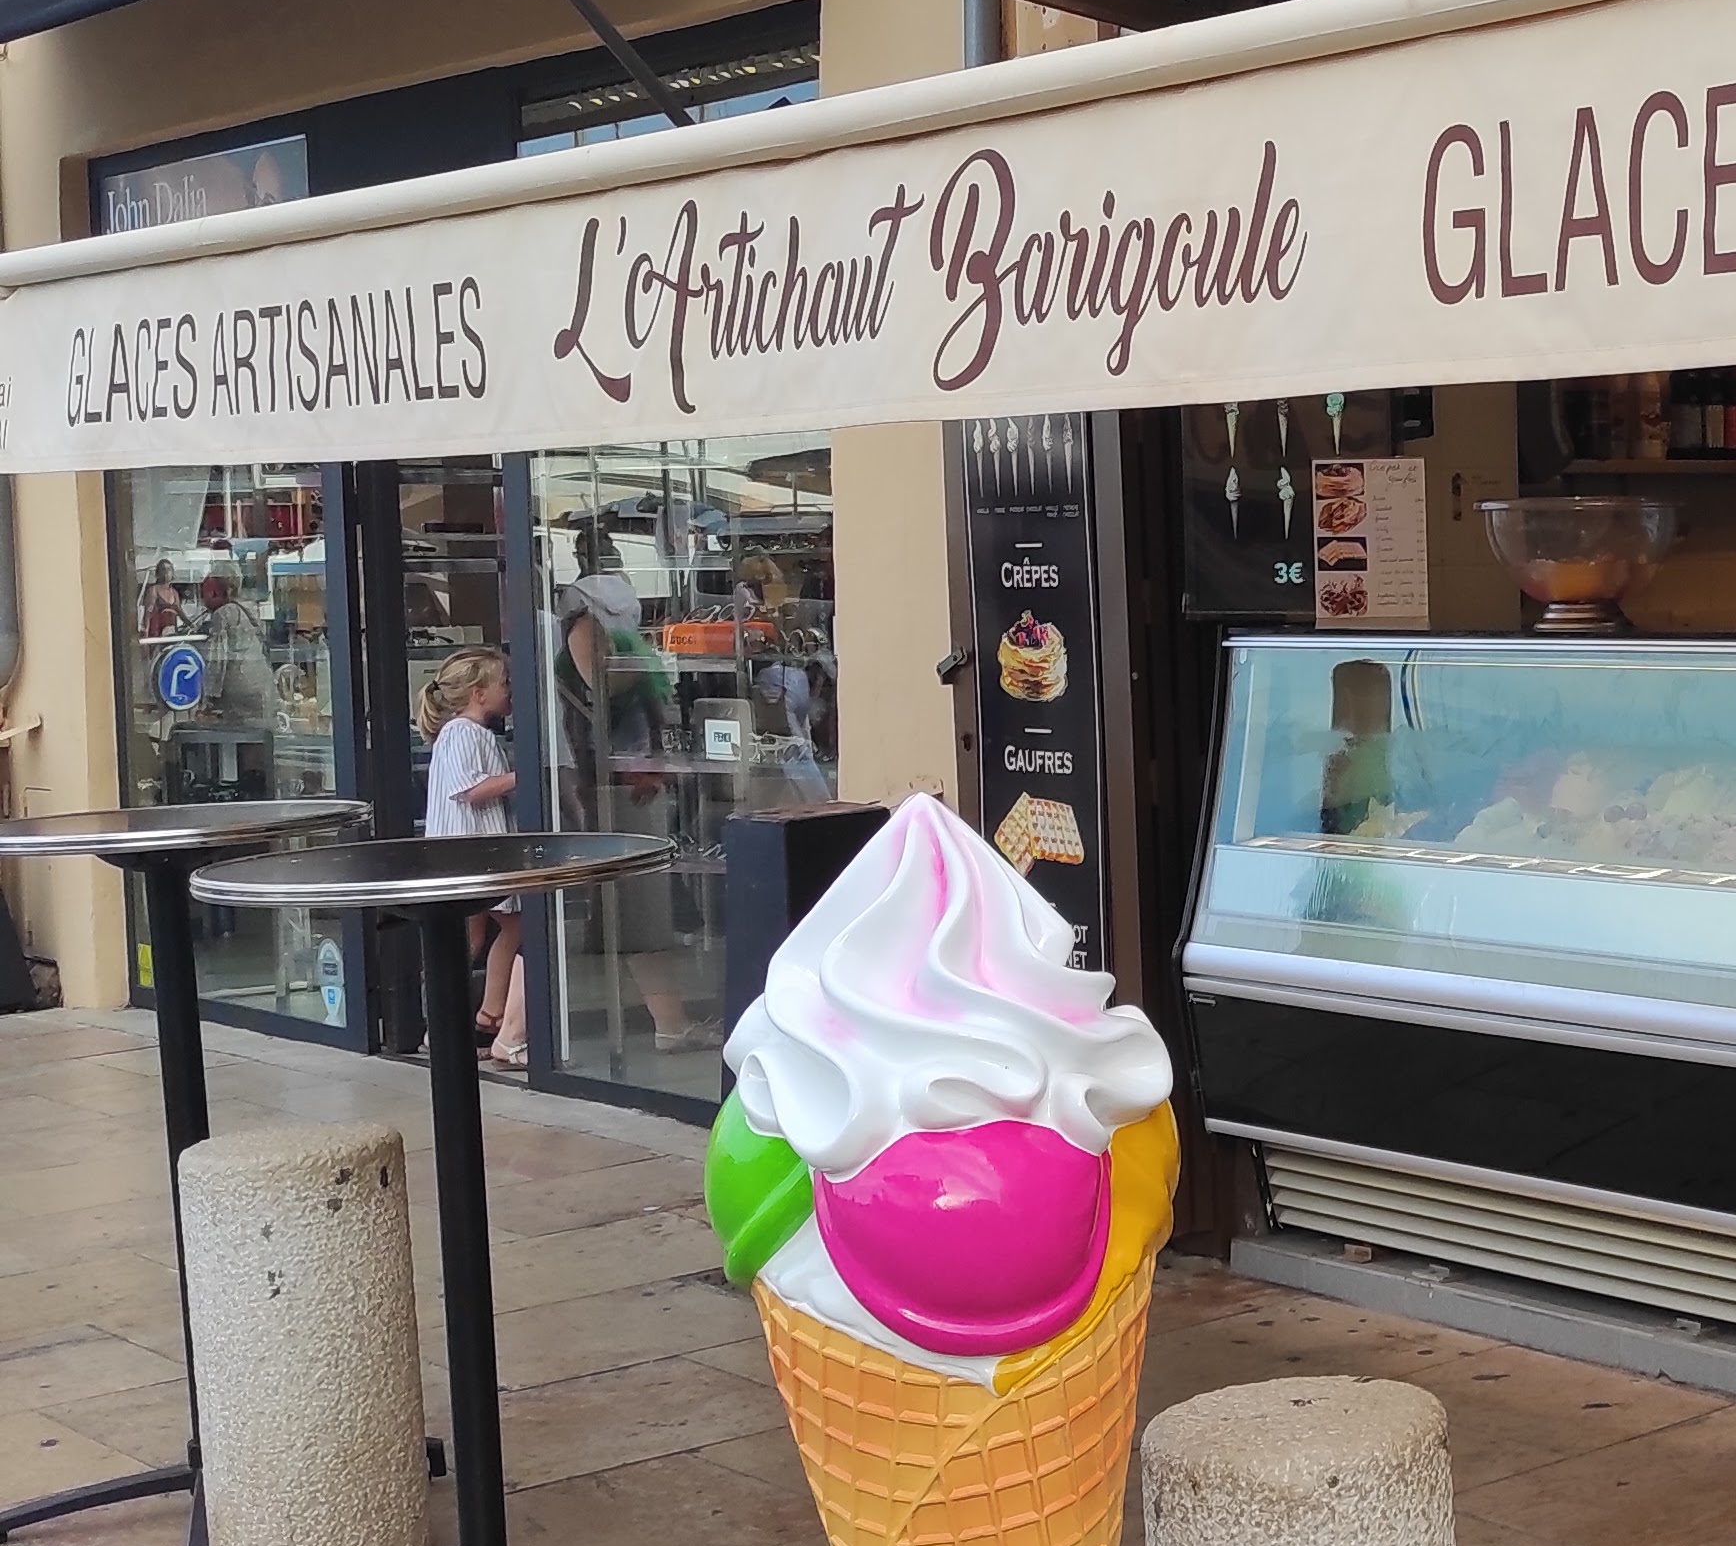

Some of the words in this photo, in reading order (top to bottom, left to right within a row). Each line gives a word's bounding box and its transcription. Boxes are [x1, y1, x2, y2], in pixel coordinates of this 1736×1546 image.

[106, 190, 150, 232] John
[67, 314, 198, 427] GLACES
[212, 276, 487, 417] ARTISANALES
[553, 183, 925, 415] L'Artichaut
[930, 140, 1307, 391] Barigoule
[1001, 557, 1059, 588] CRÊPES
[1273, 562, 1304, 584] 3€
[1004, 745, 1073, 774] GAUFRES
